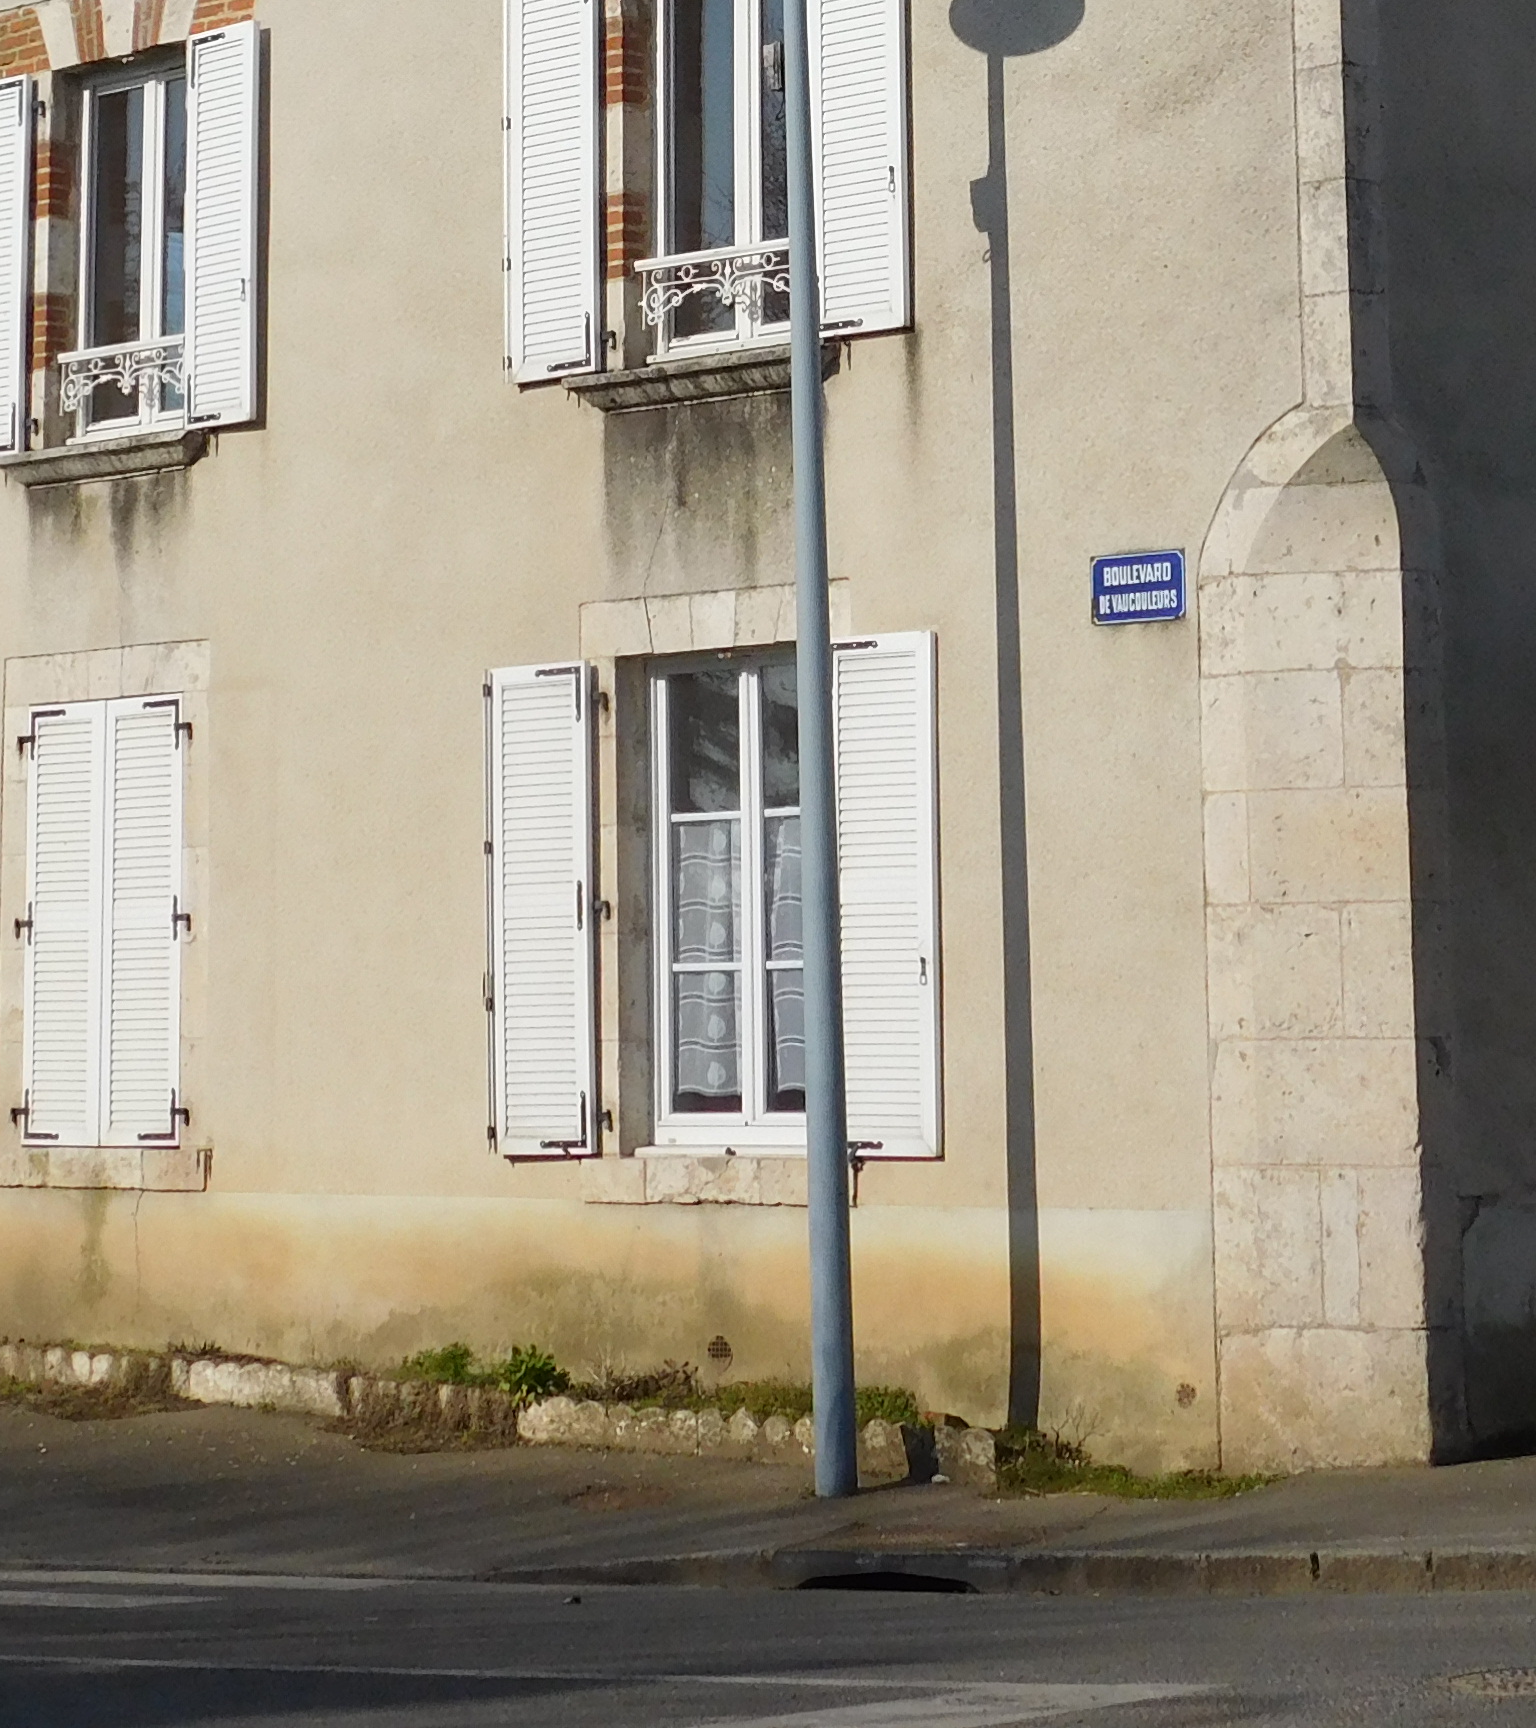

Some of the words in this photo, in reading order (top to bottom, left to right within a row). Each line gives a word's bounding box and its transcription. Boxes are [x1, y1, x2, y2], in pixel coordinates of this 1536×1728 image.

[1103, 562, 1171, 587] BOULEVARD
[1099, 594, 1111, 615] DE
[1112, 589, 1177, 613] VAUCOULEURS
